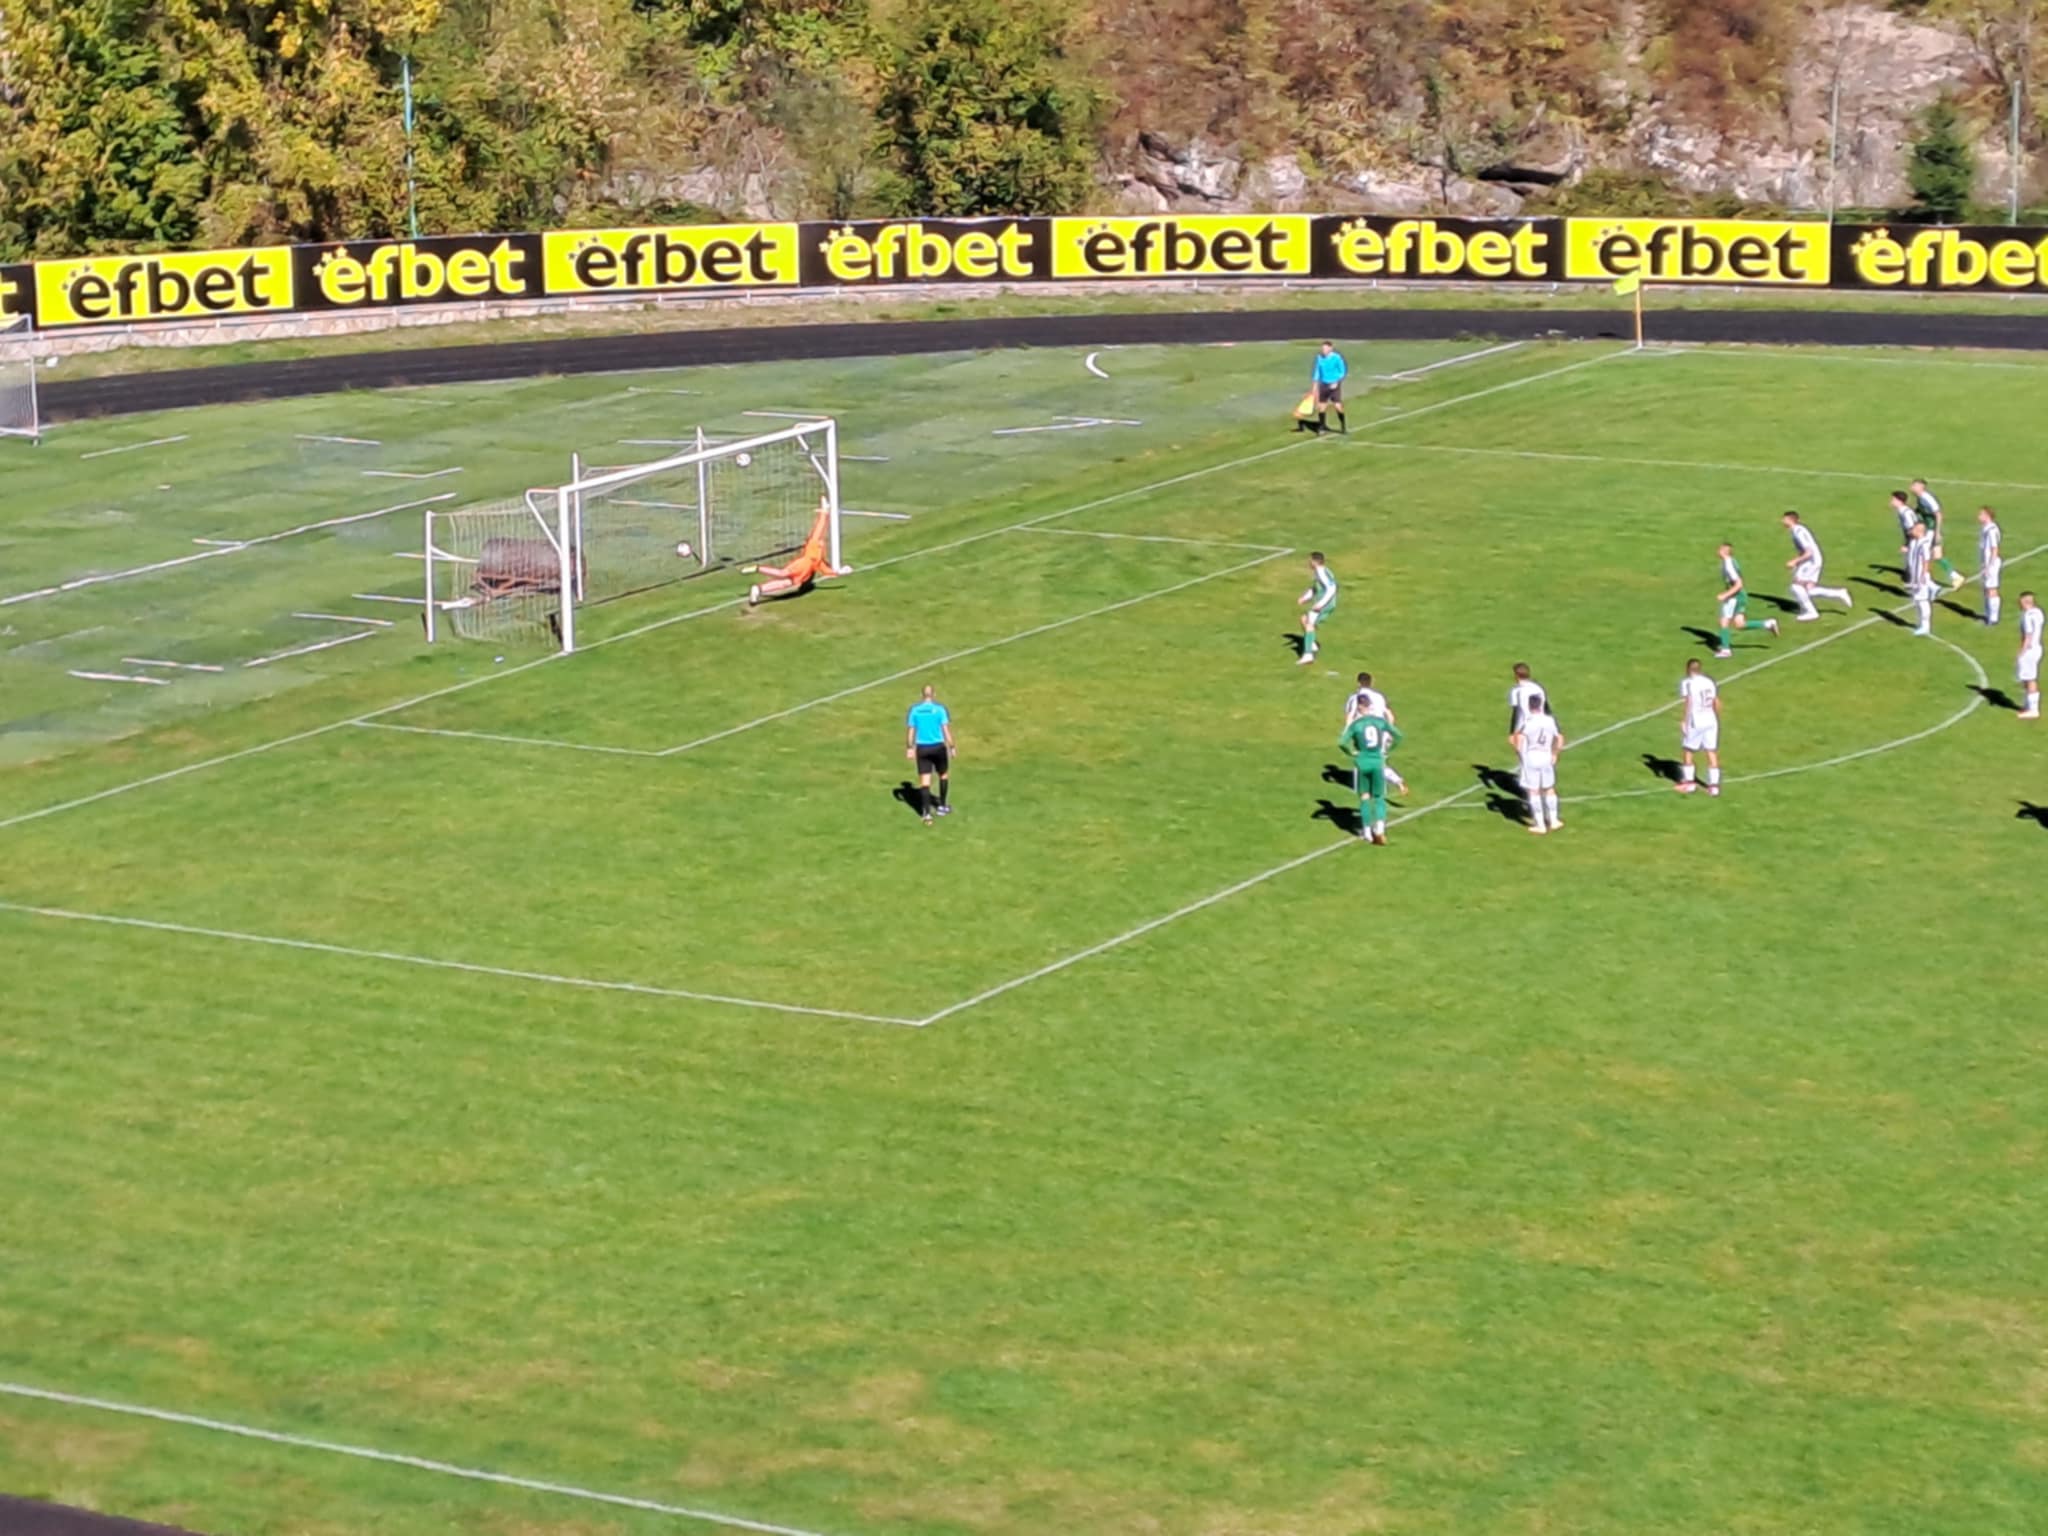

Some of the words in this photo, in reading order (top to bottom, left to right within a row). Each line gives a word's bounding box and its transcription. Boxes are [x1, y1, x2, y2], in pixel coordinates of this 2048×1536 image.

[312, 239, 527, 304] efbet
[568, 230, 779, 288] efbet
[819, 223, 1034, 280] efbet
[1077, 221, 1289, 272] efbet
[1331, 217, 1549, 276] efbet
[1592, 224, 1807, 280] efbet
[62, 255, 271, 318] efbet
[1364, 725, 1379, 748] 9
[1536, 727, 1547, 746] 4
